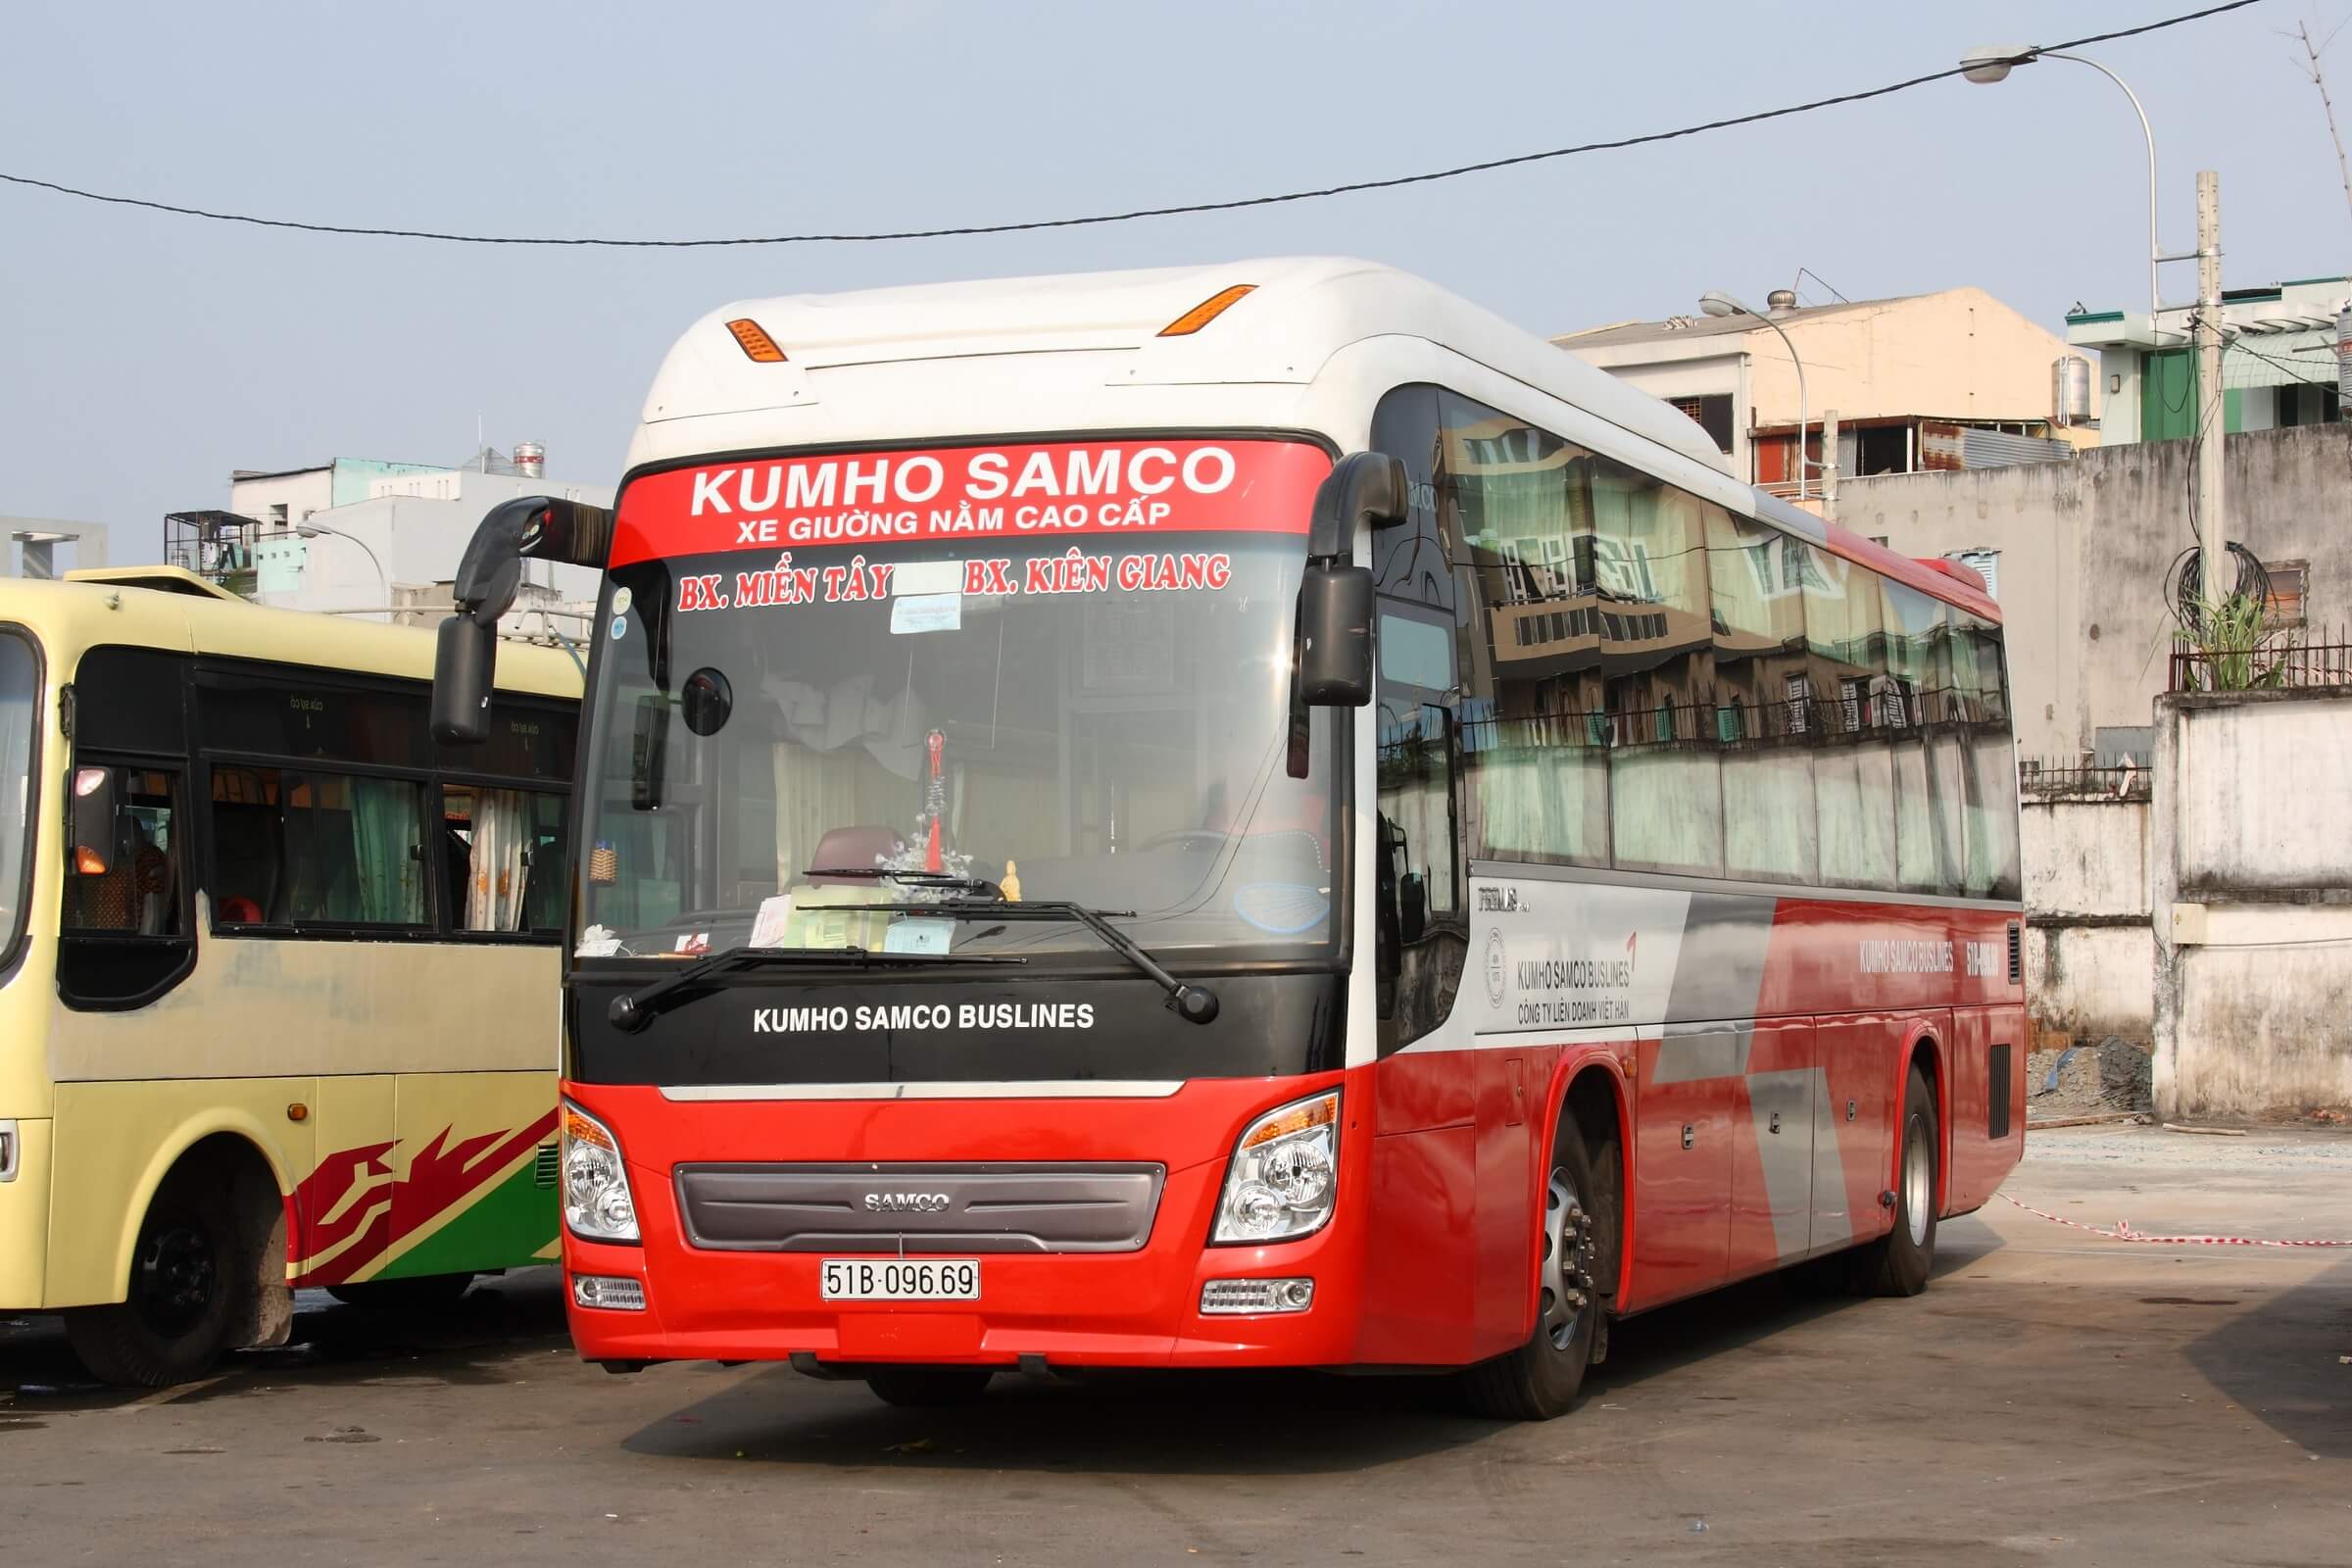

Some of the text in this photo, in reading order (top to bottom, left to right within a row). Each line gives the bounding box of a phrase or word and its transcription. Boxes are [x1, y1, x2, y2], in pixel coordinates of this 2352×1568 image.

[690, 446, 1236, 516] KUMHO SAMCO
[736, 495, 1172, 544] XE GIƯỜNG NẰM CAO CẤP
[677, 551, 895, 612] BX. MIỀN TÂY
[963, 546, 1233, 597] BX. KIÊN GIANG
[1859, 940, 1889, 973] KUMHO
[1889, 941, 1918, 973] SAMCO
[1517, 959, 1630, 990] KUMHO SAMCO BUSLINES
[753, 1004, 1095, 1033] KUMHO SAMCO BUSLINES
[1543, 1003, 1552, 1023] TY
[1572, 1001, 1597, 1022] DOANH
[864, 1193, 951, 1212] SAMCO
[826, 1264, 974, 1296] 51B-096.69
